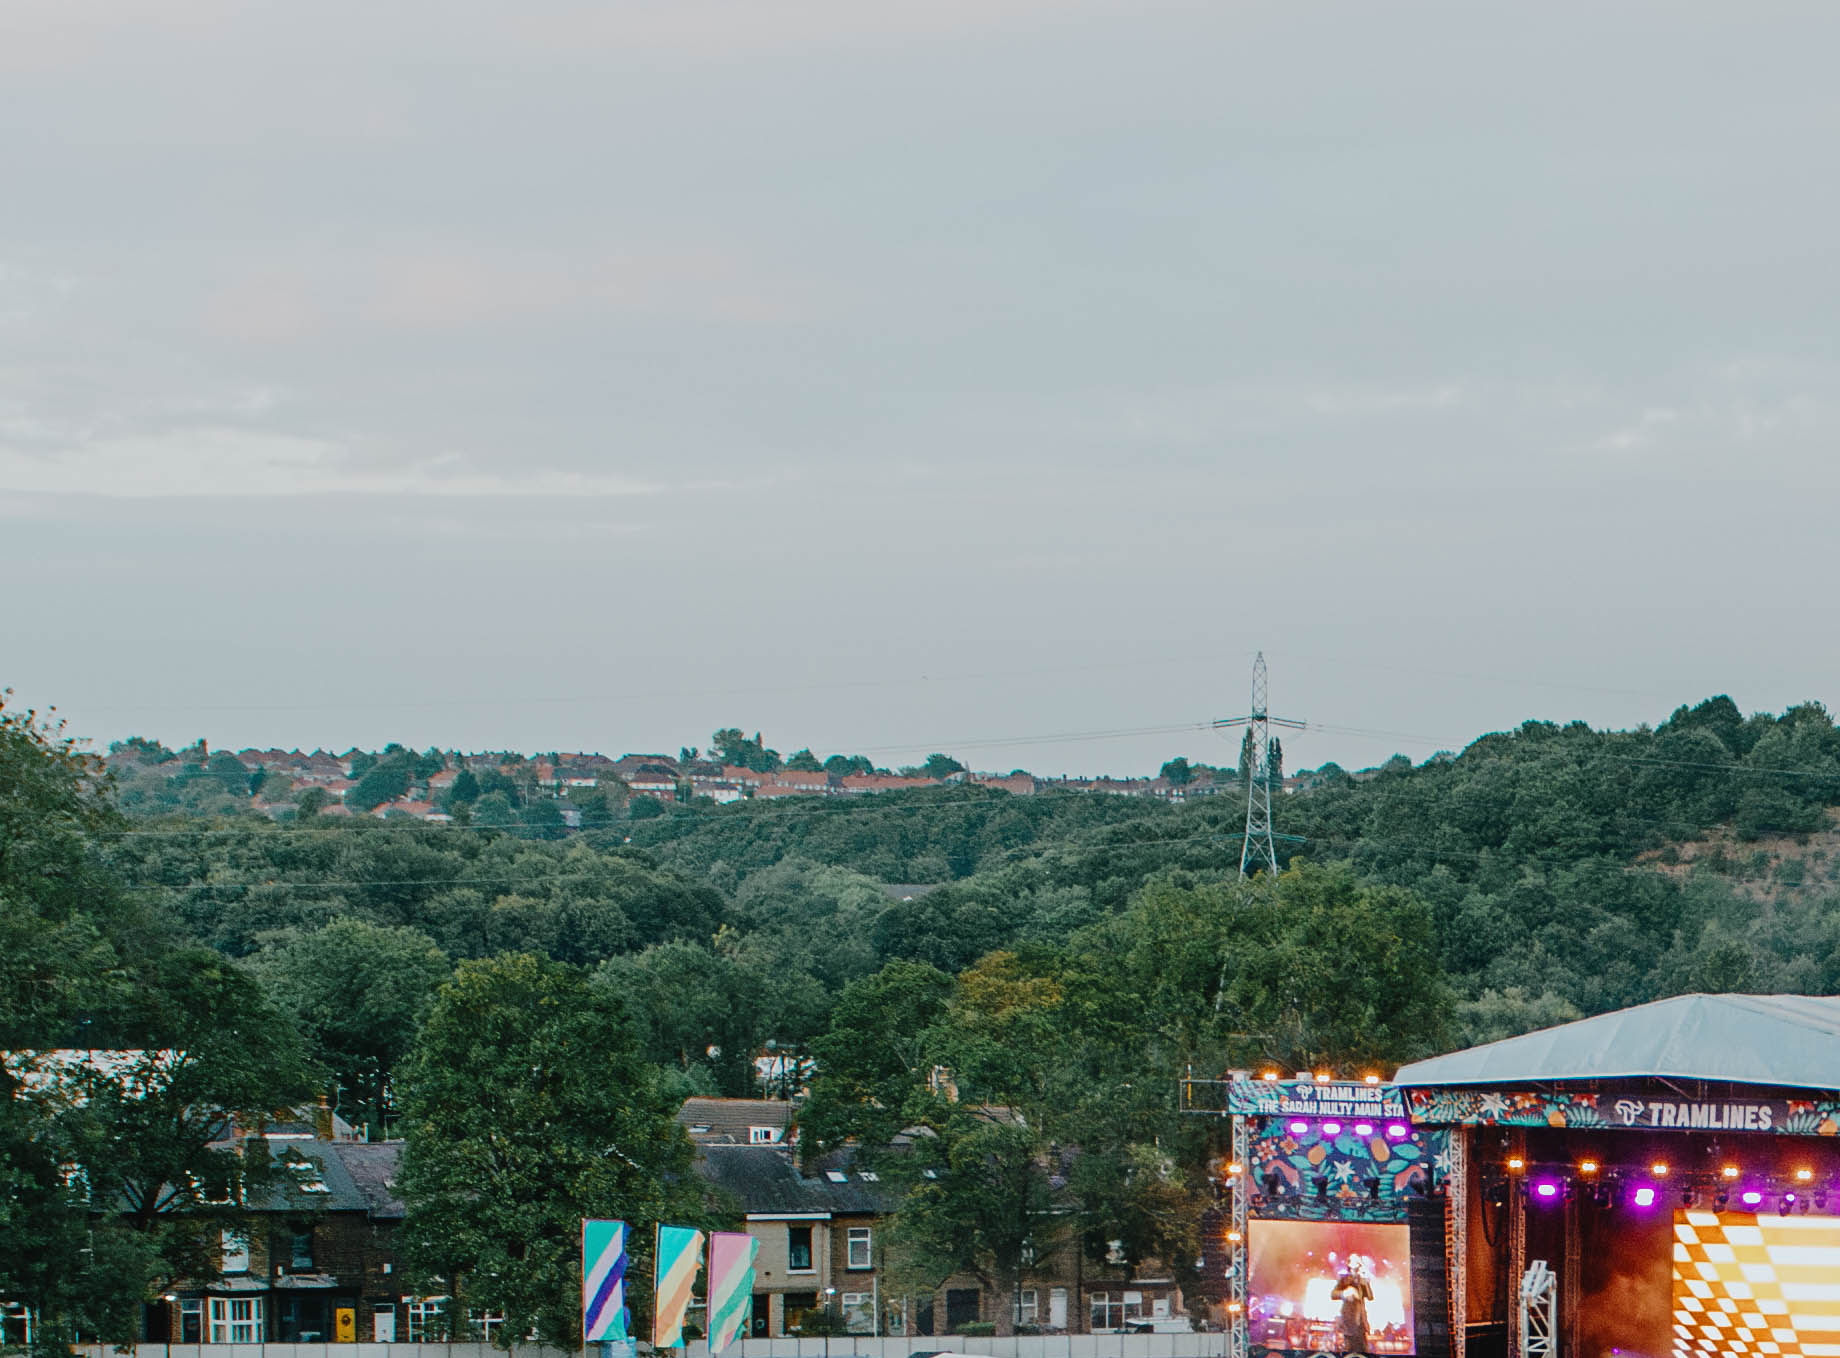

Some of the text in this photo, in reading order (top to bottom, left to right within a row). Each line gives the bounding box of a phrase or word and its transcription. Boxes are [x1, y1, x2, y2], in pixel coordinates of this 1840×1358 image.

[1315, 1086, 1382, 1101] TRAMLINES
[1258, 1100, 1278, 1114] THE
[1281, 1101, 1317, 1114] SARAH
[1320, 1103, 1353, 1115] NULTY
[1355, 1103, 1382, 1116] MAIN
[1648, 1102, 1772, 1130] TRAMLINES
